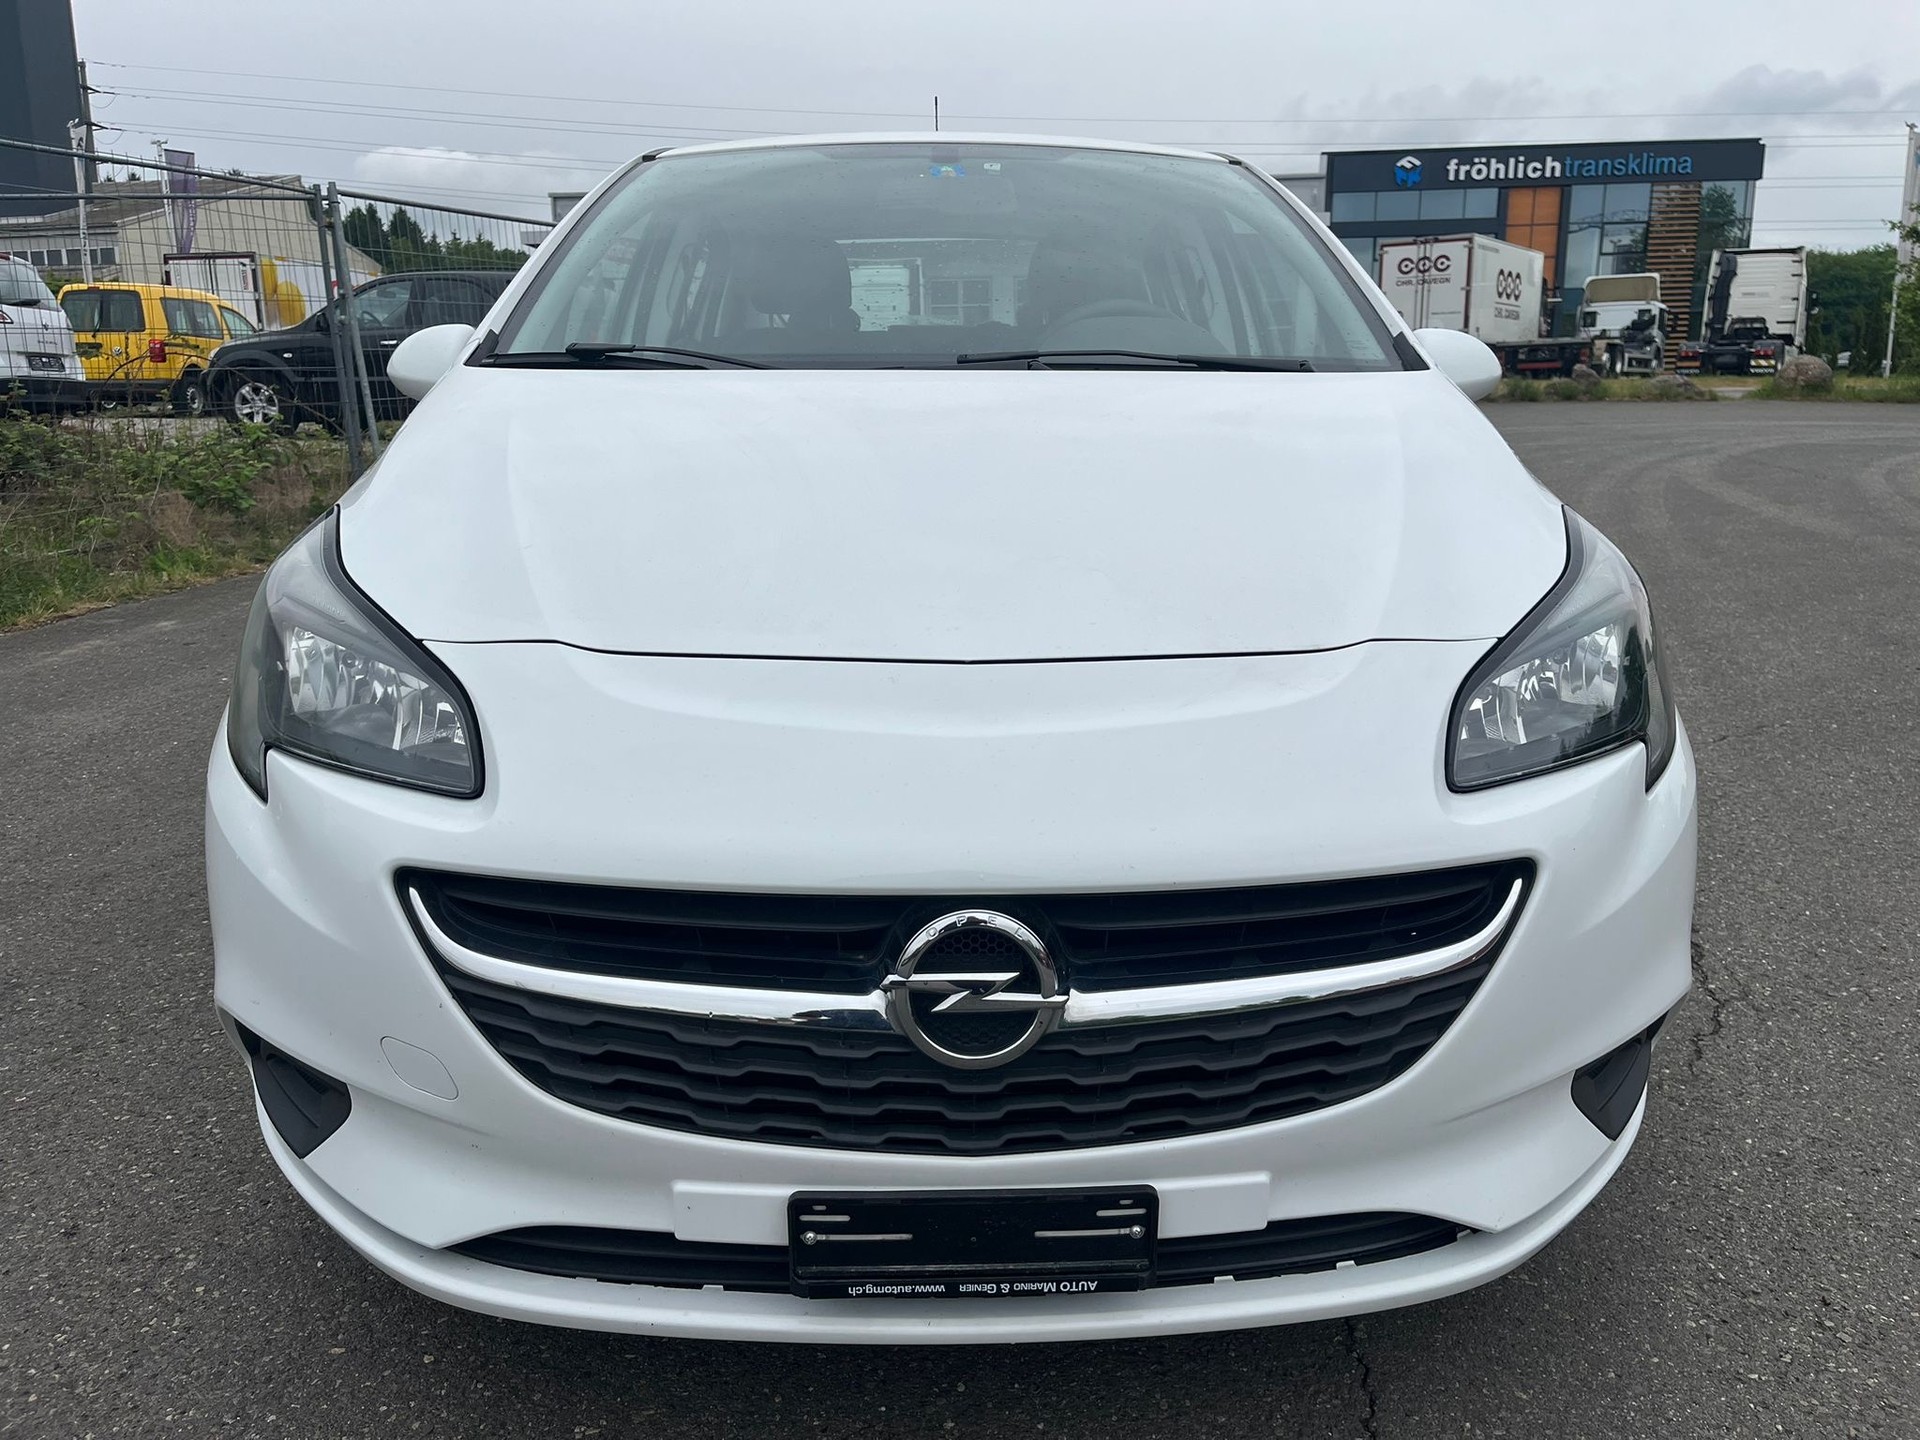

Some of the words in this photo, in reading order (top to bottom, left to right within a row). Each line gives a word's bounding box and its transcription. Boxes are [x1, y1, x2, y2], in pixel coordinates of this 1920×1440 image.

[925, 915, 1025, 941] OPEL
[848, 1284, 946, 1296] www.automg.ch
[1000, 1283, 1010, 1293] &
[1060, 1281, 1098, 1291] AUTO
